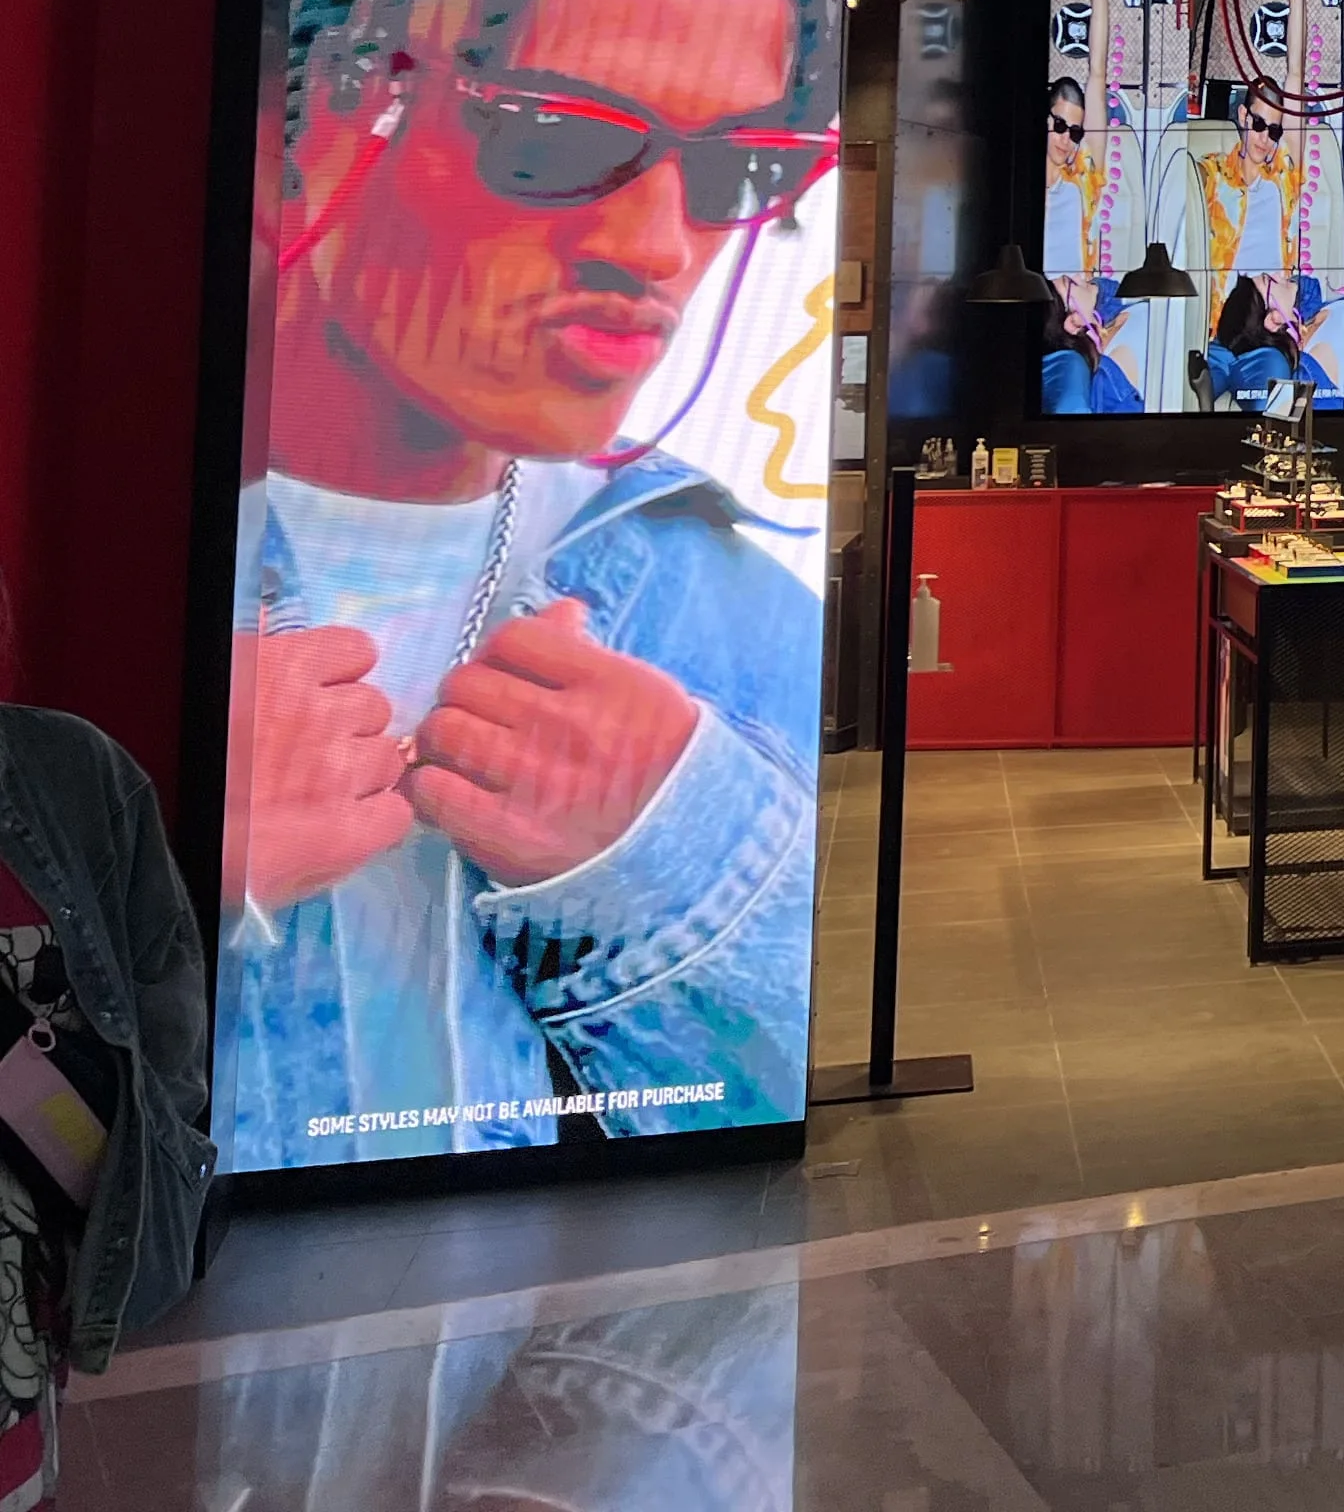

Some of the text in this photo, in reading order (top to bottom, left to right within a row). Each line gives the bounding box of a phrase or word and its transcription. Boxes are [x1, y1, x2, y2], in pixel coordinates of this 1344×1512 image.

[307, 1082, 725, 1137] SOME STYLES MAY NOT BE AVAILABLE FOR PURCHASE
